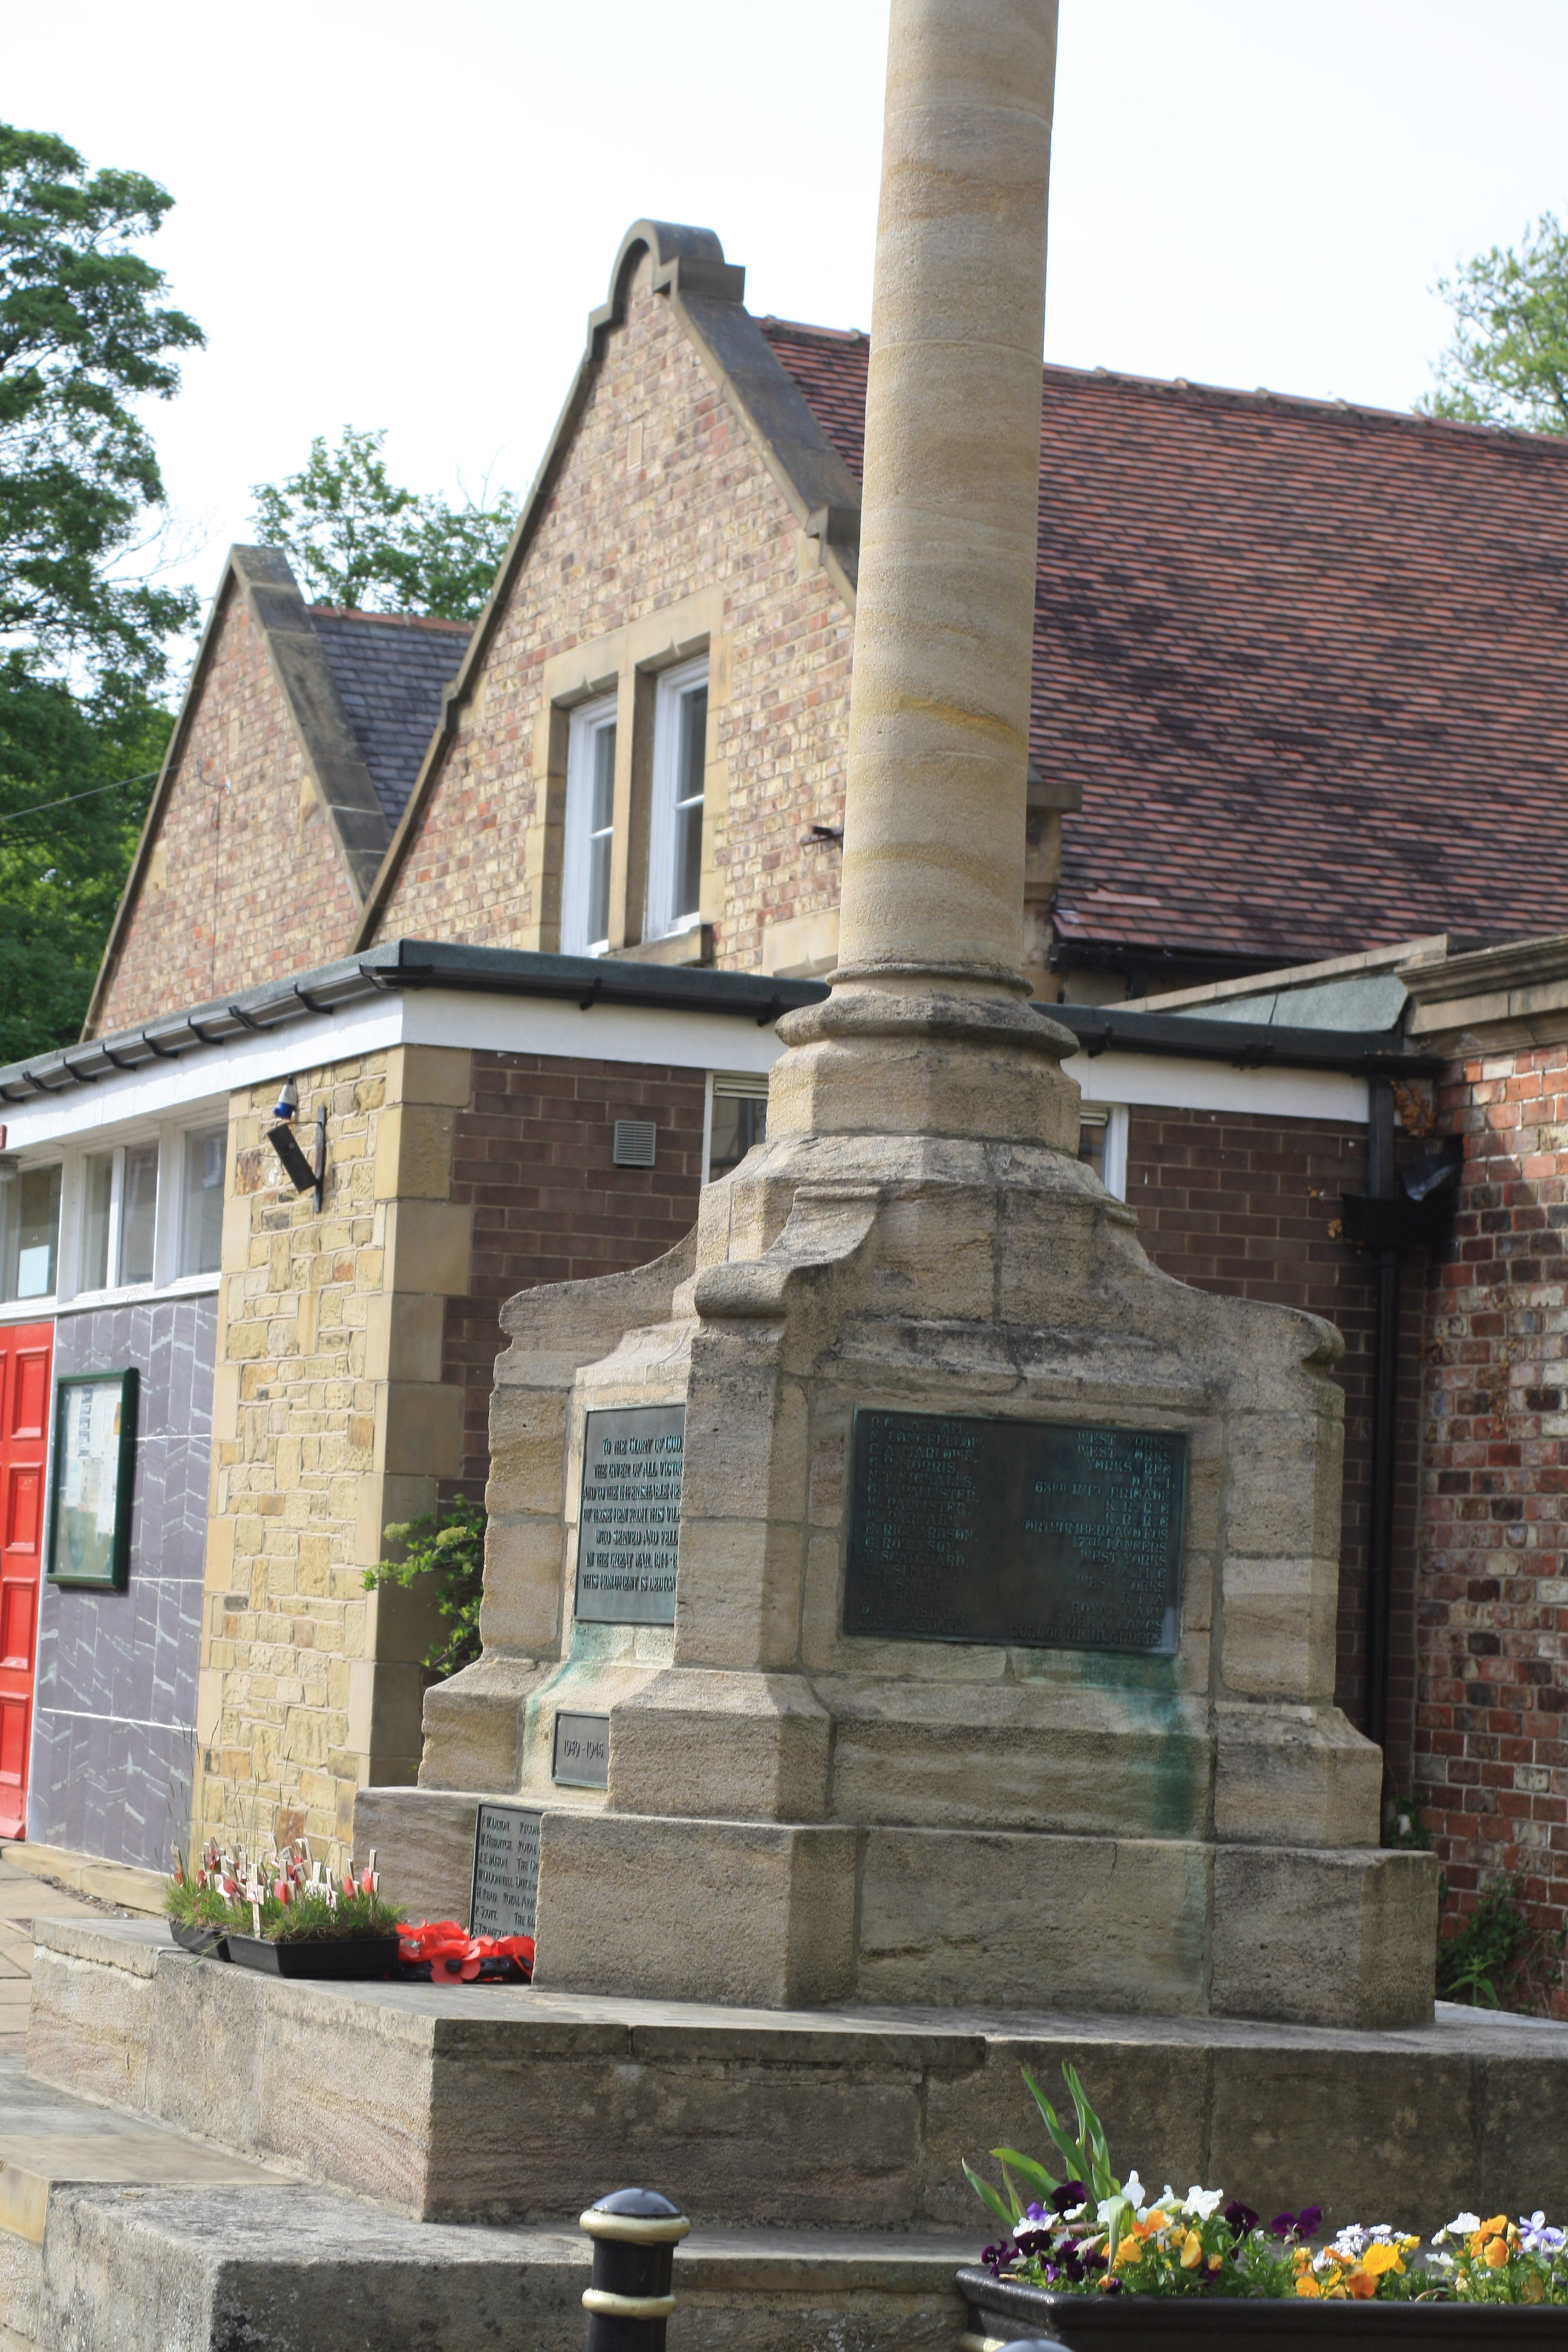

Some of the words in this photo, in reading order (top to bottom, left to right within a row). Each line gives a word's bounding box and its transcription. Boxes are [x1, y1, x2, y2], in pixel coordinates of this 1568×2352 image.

[603, 1438, 611, 1455] TO
[612, 1439, 627, 1455] THE
[629, 1437, 653, 1454] GLORY
[653, 1438, 664, 1454] OF
[1077, 1432, 1116, 1446] WEST
[1128, 1437, 1171, 1449] YORKS
[1077, 1445, 1116, 1459] WEST
[1128, 1449, 1171, 1462] YORKS
[593, 1463, 607, 1478] THE
[609, 1463, 630, 1478] GIVER
[632, 1462, 642, 1478] OF
[642, 1461, 657, 1477] ALL
[1086, 1459, 1132, 1472] YORKS
[1144, 1464, 1171, 1474] REG
[596, 1485, 606, 1500] TO
[606, 1485, 618, 1500] THE
[619, 1483, 669, 1500] IMPERISHABLE
[1035, 1481, 1066, 1493] 63RD
[1111, 1486, 1169, 1500] BRIGADE
[592, 1508, 613, 1523] THOSE
[613, 1507, 629, 1523] MEN
[629, 1508, 648, 1523] FROM
[648, 1507, 665, 1523] THIS
[595, 1529, 611, 1545] WHO
[613, 1529, 641, 1545] SERVED
[643, 1529, 659, 1545] AND
[1143, 1529, 1168, 1541] FUS
[1073, 1536, 1100, 1548] 17TH
[1106, 1538, 1166, 1553] LANCERS
[586, 1552, 595, 1567] IN
[595, 1552, 609, 1567] THE
[610, 1552, 633, 1568] GREAT
[1080, 1550, 1117, 1564] WEST
[1125, 1553, 1166, 1567] YORKS
[582, 1574, 599, 1589] THIS
[600, 1574, 639, 1591] MONUMENT
[639, 1575, 648, 1592] IS
[1076, 1575, 1114, 1589] WEST
[1122, 1578, 1165, 1592] YORKS
[1071, 1601, 1114, 1616] ROYAL
[1057, 1613, 1095, 1627] YORK
[1010, 1625, 1063, 1639] GORDON
[1067, 1628, 1163, 1645] HIGHLANDERS
[517, 1840, 537, 1855] ROYAL
[517, 1858, 528, 1871] THE
[515, 1875, 531, 1890] DUKE
[503, 1892, 520, 1907] ROYAL
[514, 1912, 525, 1926] THE
